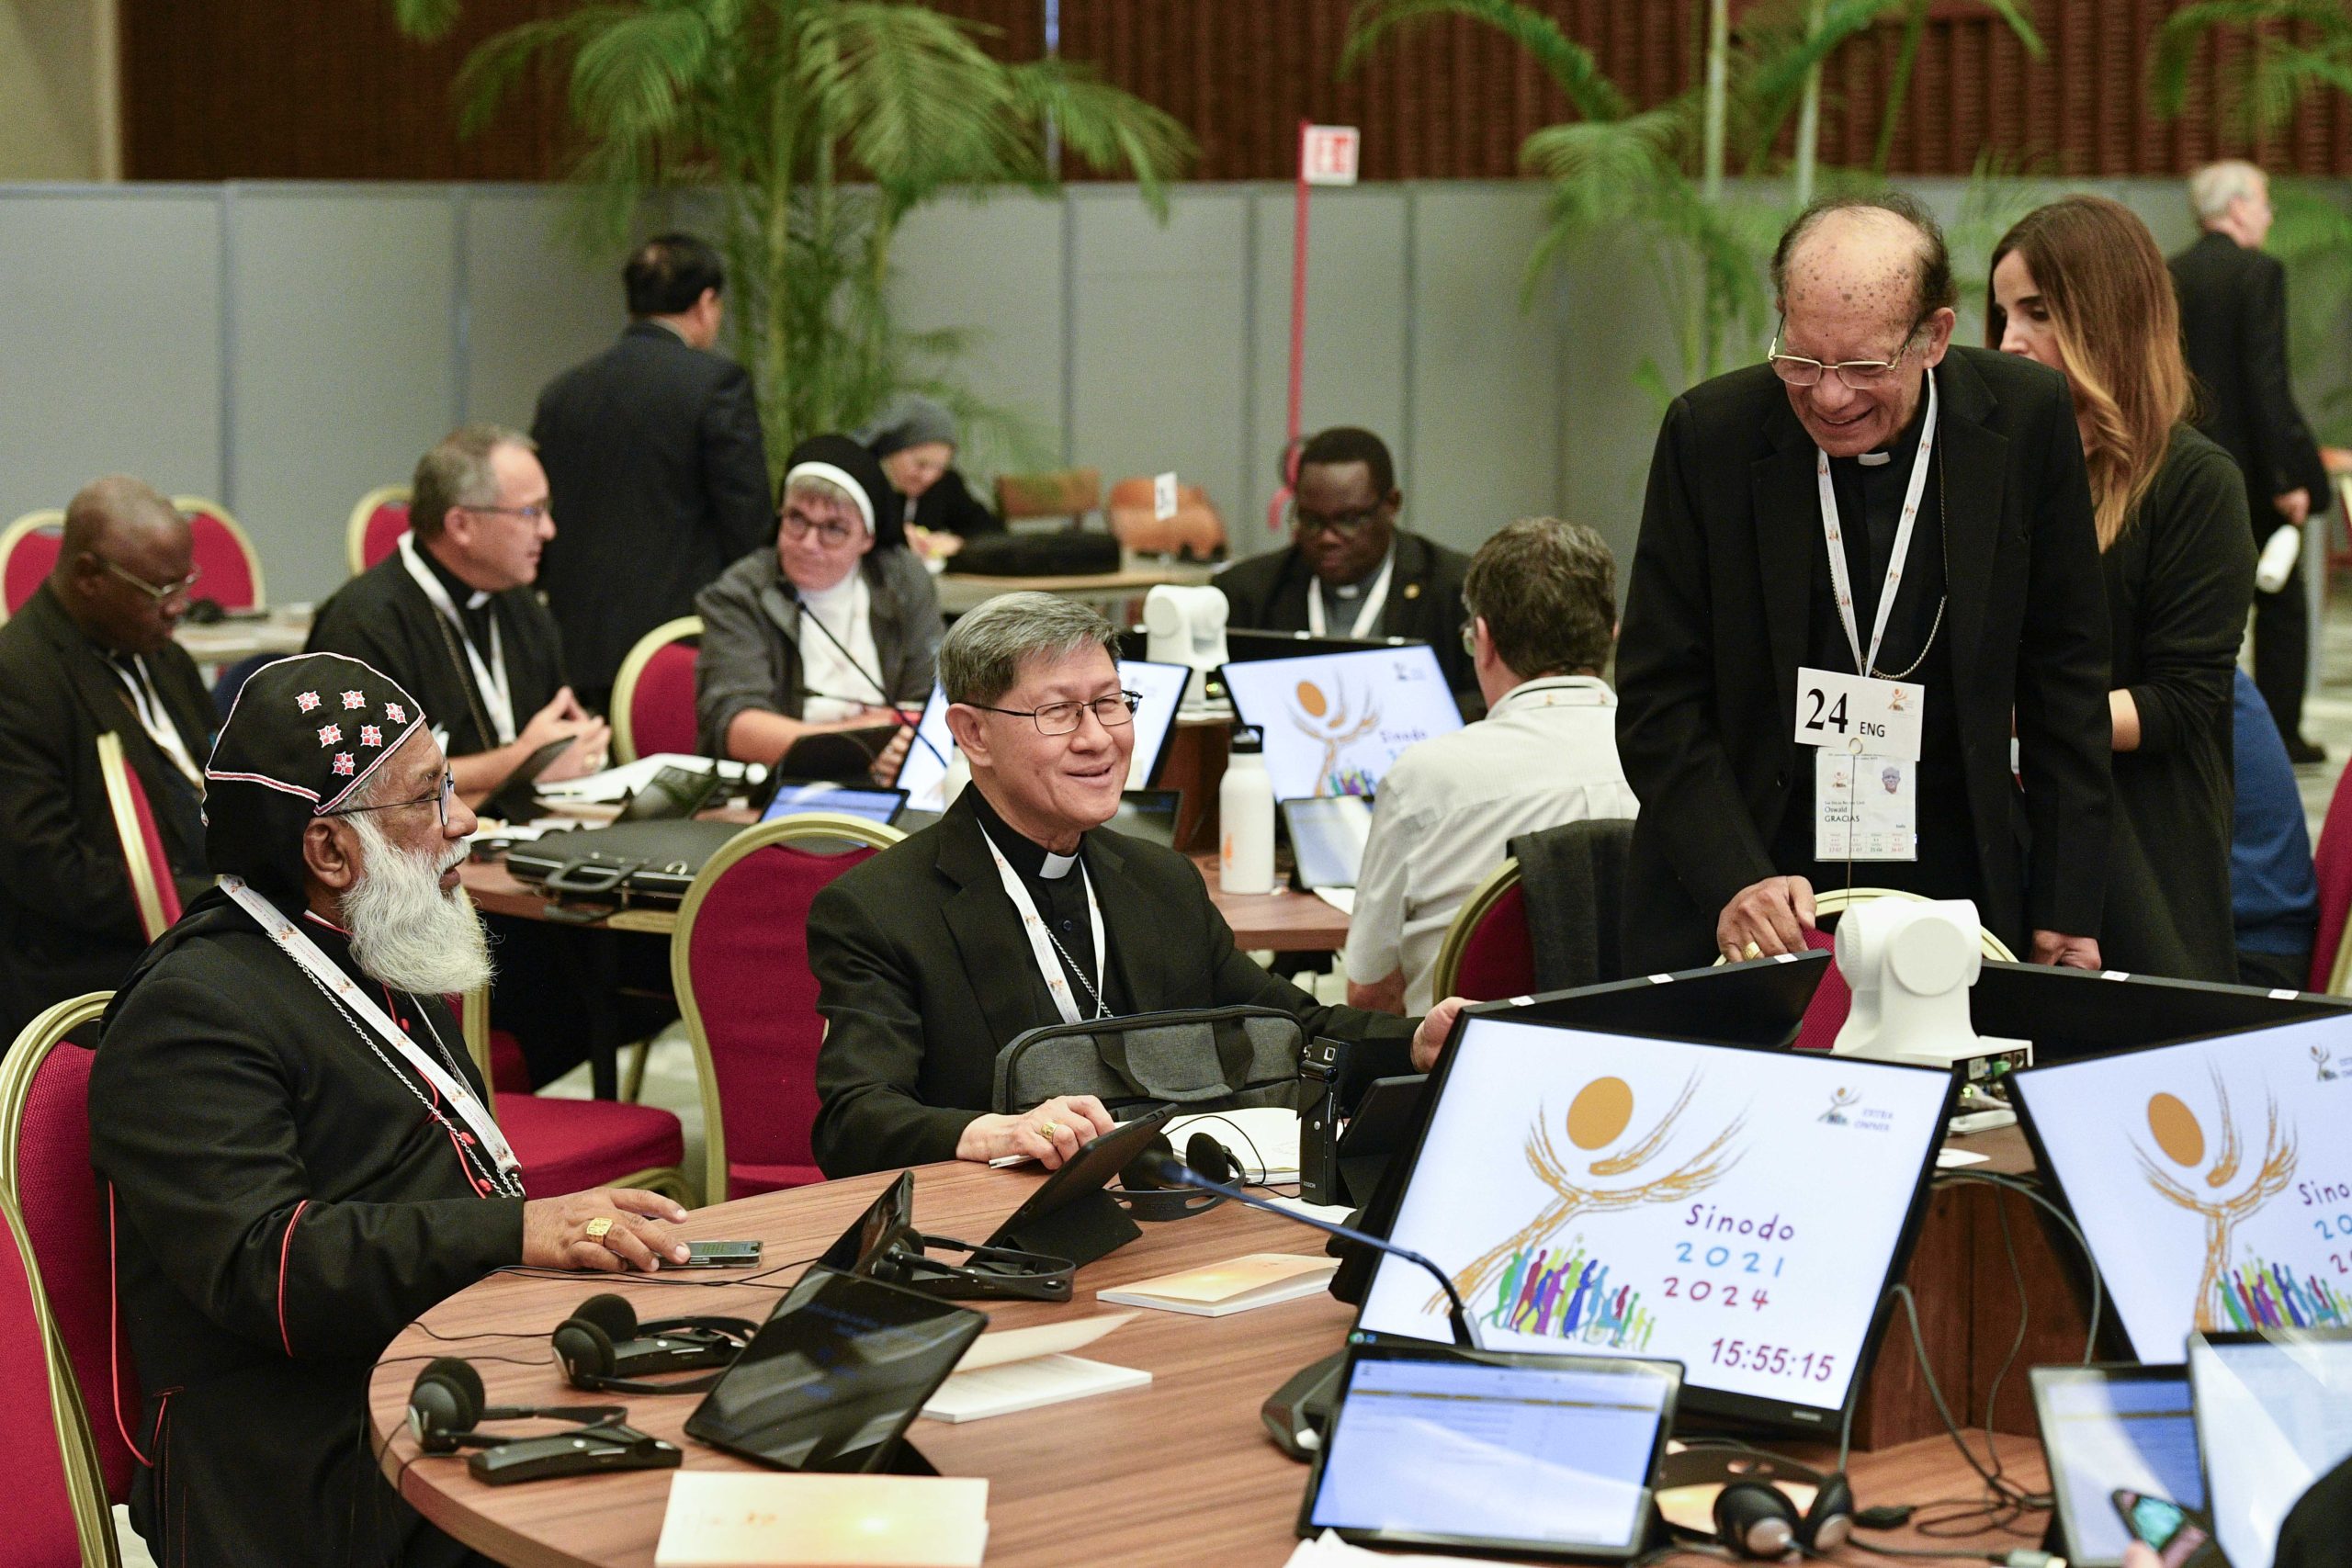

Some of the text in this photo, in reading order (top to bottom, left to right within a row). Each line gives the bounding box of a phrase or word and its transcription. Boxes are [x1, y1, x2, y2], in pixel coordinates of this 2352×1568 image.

[1804, 688, 1886, 738] 24 ENG
[1824, 815, 1860, 823] GRACIAS
[2299, 1179, 2352, 1205] Sino
[1685, 1203, 1794, 1241] Sinodo
[2314, 1214, 2352, 1239] 20
[1676, 1242, 1784, 1278] 2021
[1663, 1277, 1770, 1311] 2024
[1712, 1337, 1836, 1382] 15:55:15
